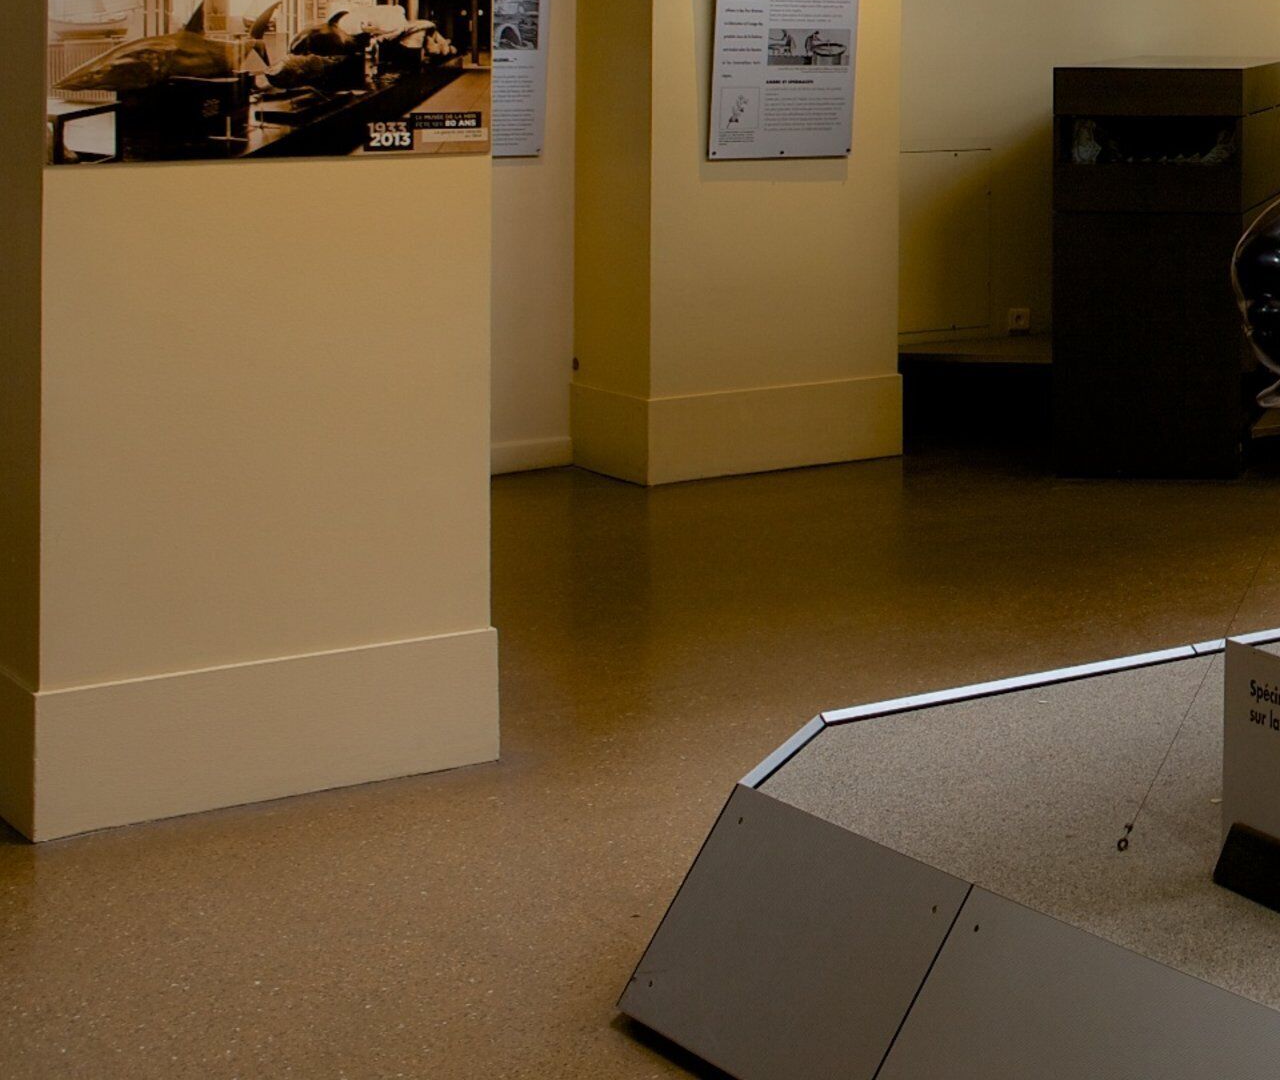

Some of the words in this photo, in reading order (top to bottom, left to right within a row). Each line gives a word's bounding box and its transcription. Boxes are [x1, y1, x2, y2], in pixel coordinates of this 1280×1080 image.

[367, 121, 407, 133] 1933
[457, 119, 477, 127] ANS
[369, 132, 412, 147] 2013
[1249, 709, 1267, 726] sur
[1269, 710, 1280, 732] la
